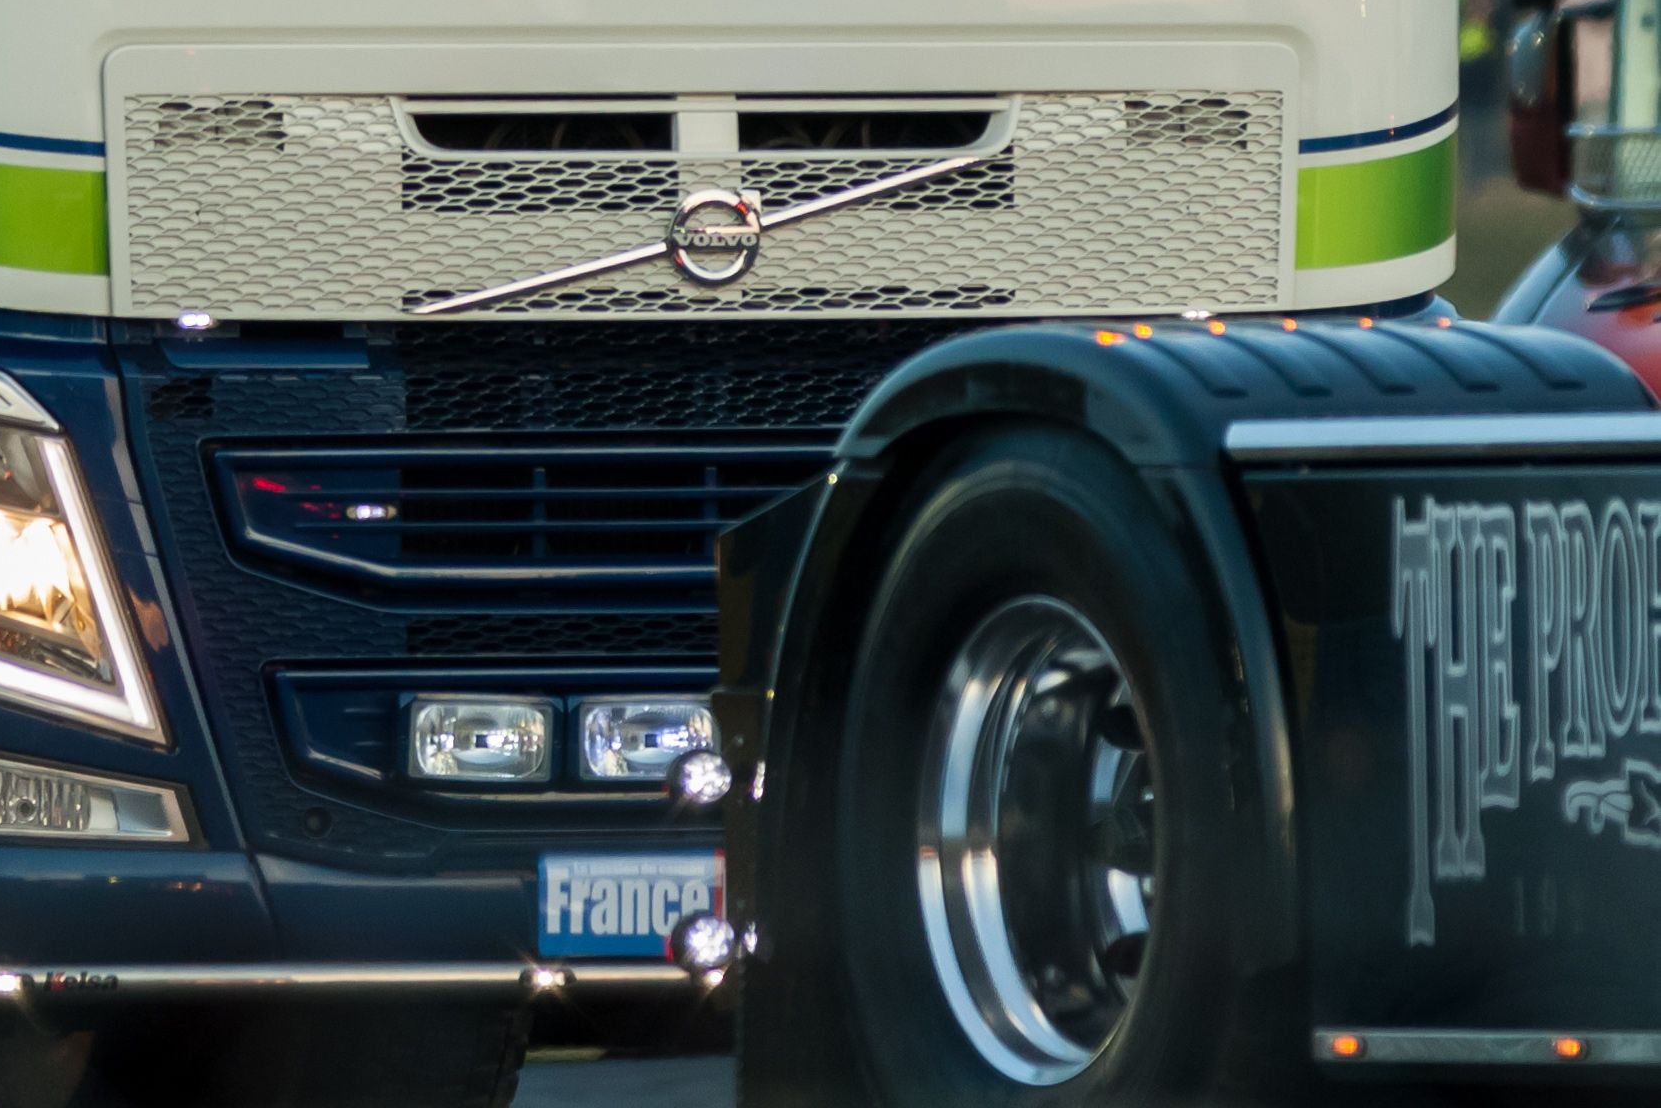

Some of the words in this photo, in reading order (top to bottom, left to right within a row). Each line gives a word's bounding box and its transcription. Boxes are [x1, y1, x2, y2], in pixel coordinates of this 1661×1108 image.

[673, 233, 758, 247] VOLVO
[1391, 494, 1521, 947] THE
[546, 866, 710, 936] France
